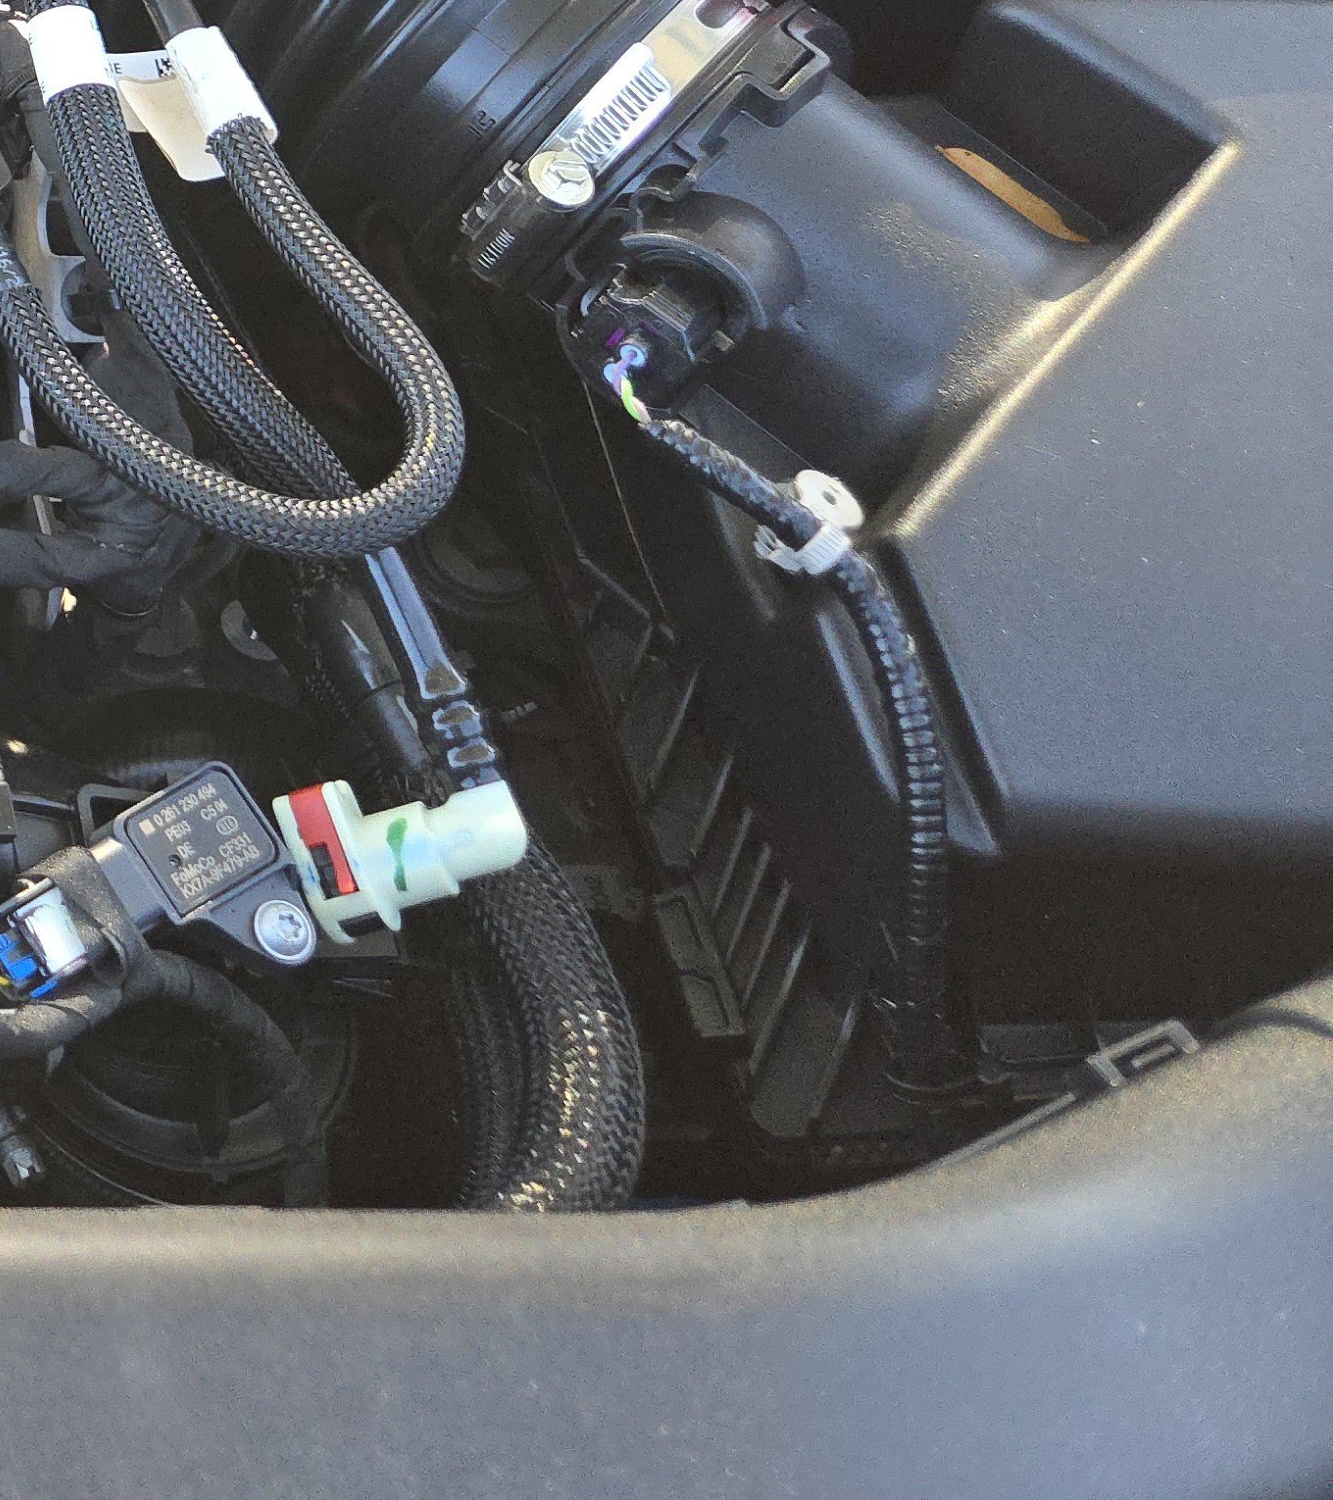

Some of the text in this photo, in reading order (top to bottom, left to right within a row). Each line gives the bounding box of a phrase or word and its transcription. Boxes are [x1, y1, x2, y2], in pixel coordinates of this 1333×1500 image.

[153, 815, 164, 827] 0
[160, 805, 182, 822] 261
[176, 841, 196, 860] DE
[170, 855, 216, 887] FoMoCo
